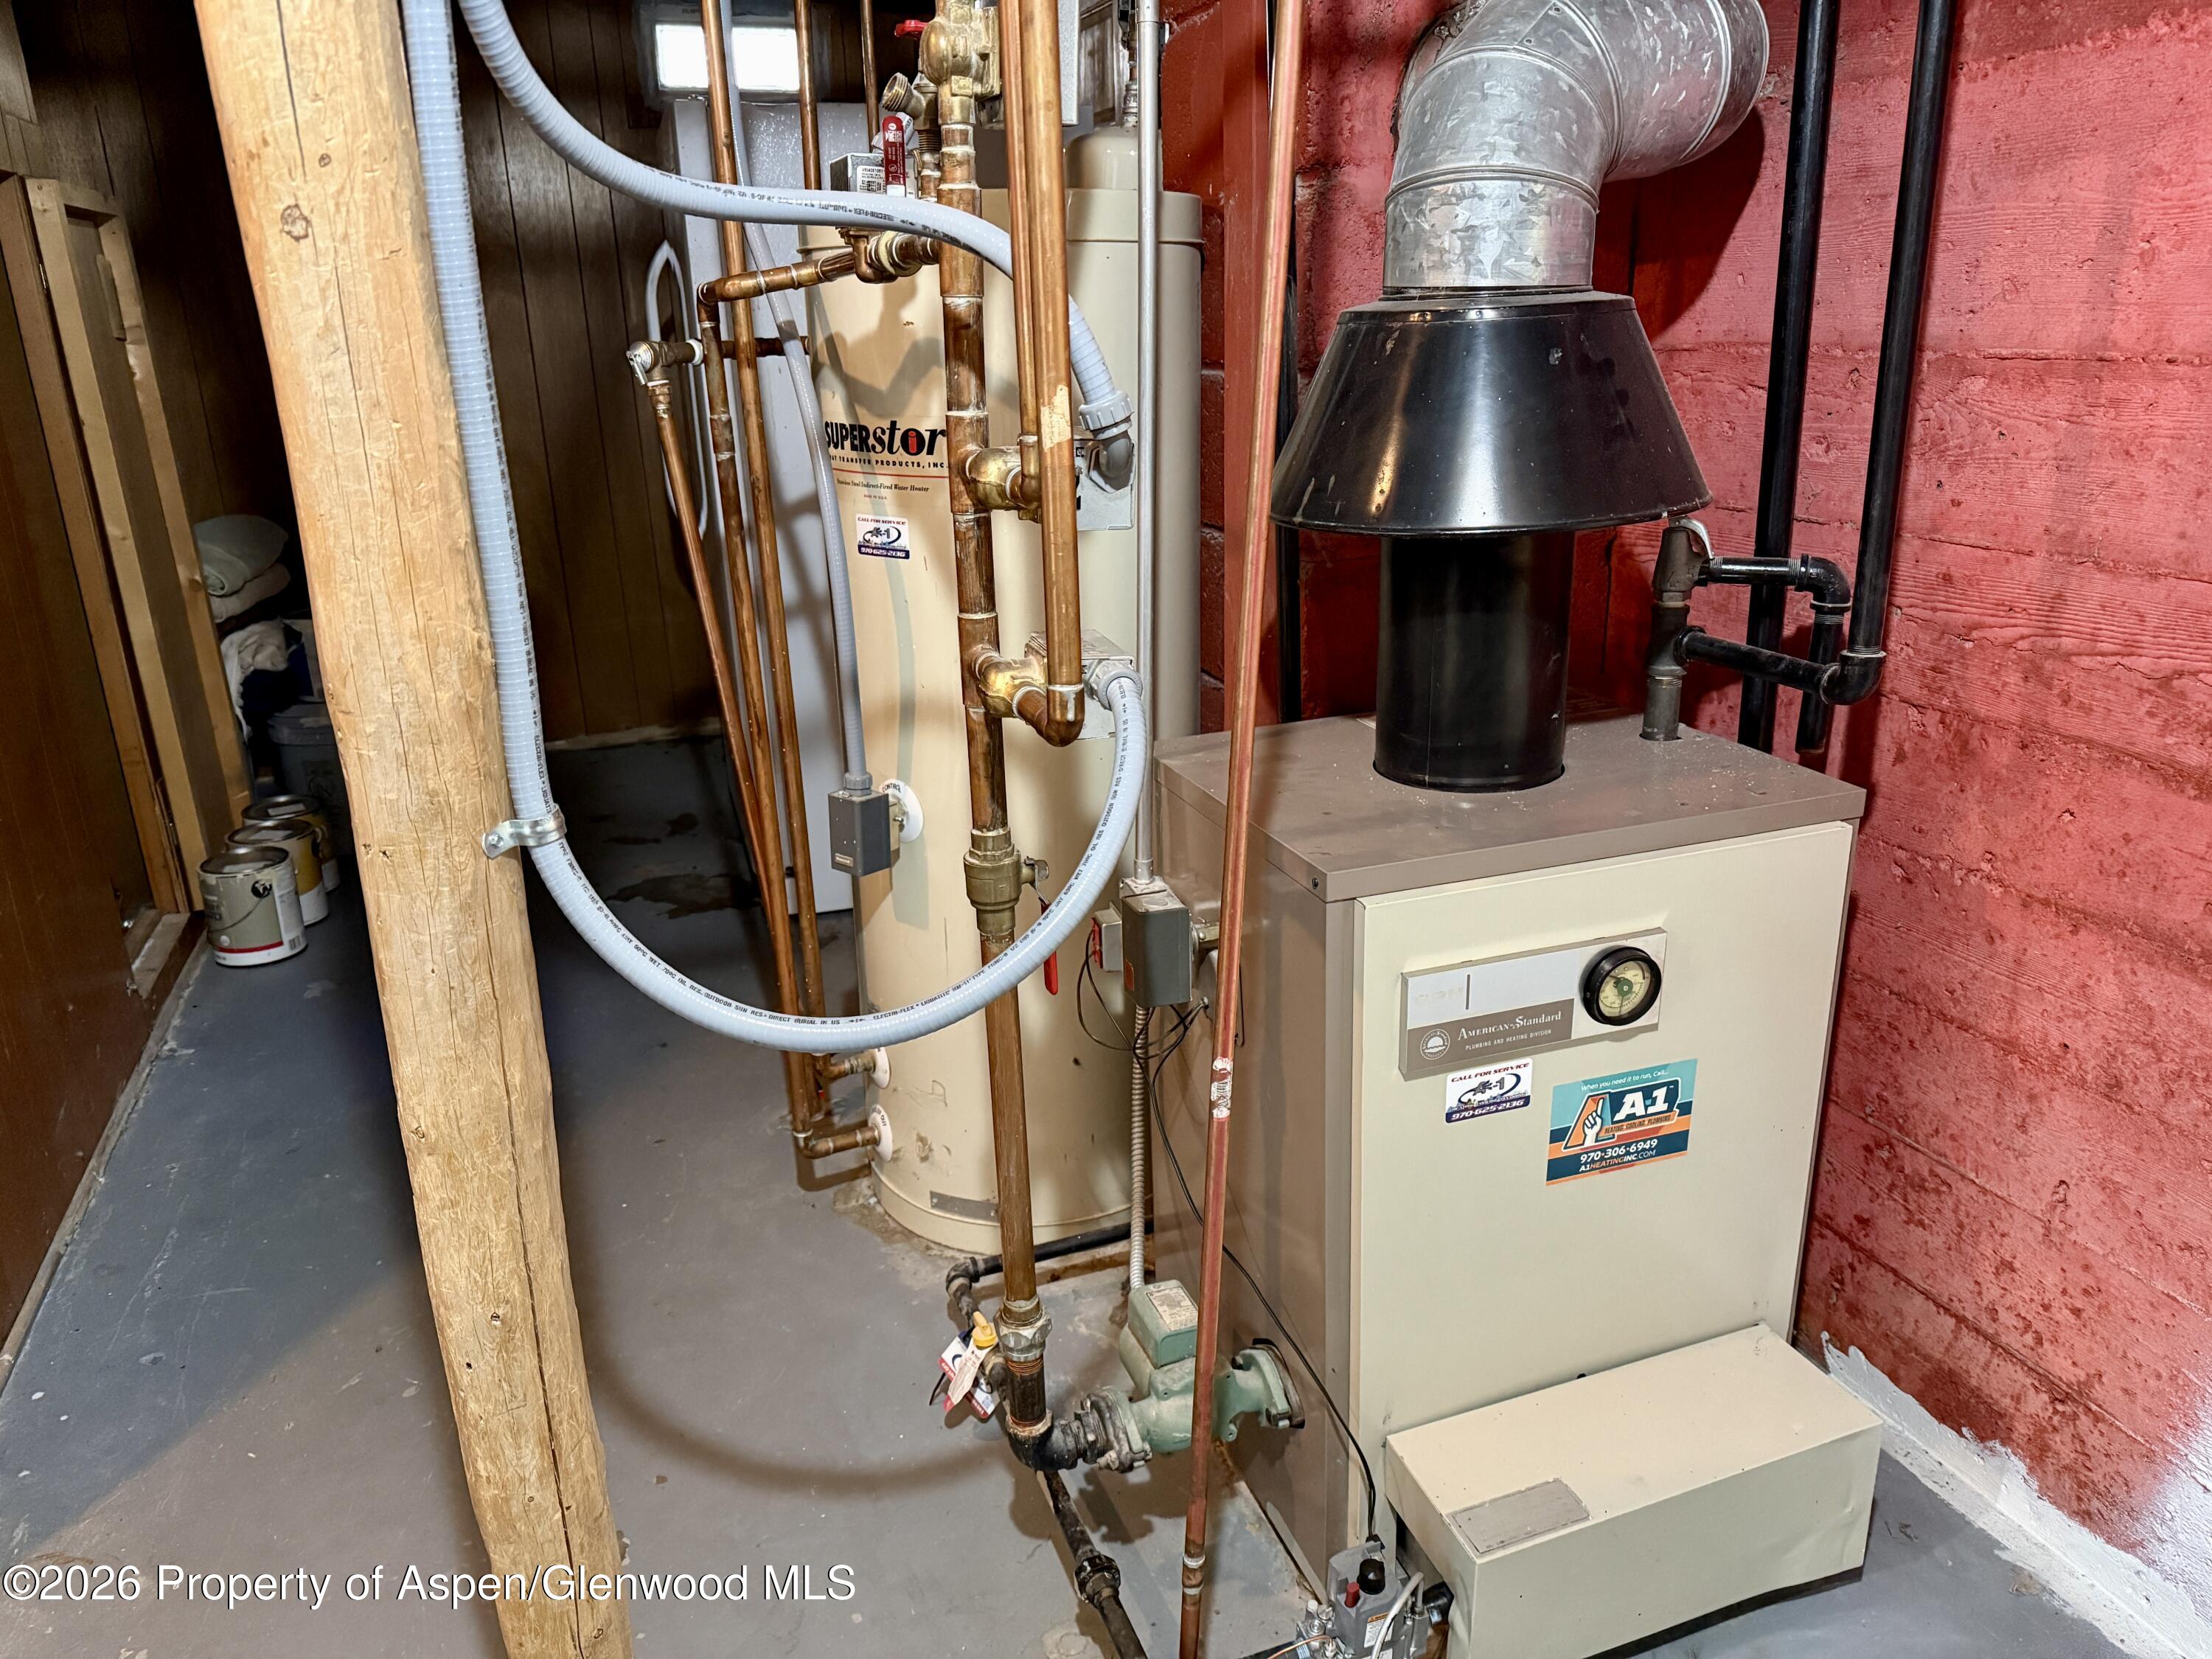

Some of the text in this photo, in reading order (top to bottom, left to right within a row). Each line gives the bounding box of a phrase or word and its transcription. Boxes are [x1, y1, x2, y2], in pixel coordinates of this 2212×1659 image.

[839, 456, 872, 465] TRANSFER
[875, 459, 925, 469] PRODUCTS,
[910, 484, 929, 493] Heater
[1466, 1040, 1492, 1051] PLUMBING
[1506, 1033, 1528, 1042] HEATING
[1530, 1029, 1552, 1038] DIVISION
[1451, 1062, 1529, 1082] CALL FOR SERVICE
[1581, 1083, 1599, 1091] When
[1611, 1077, 1627, 1085] need
[1604, 1114, 1672, 1133] HEATING COOLING PLUMBING
[1579, 1149, 1656, 1172] A1HEATINGINC.COM
